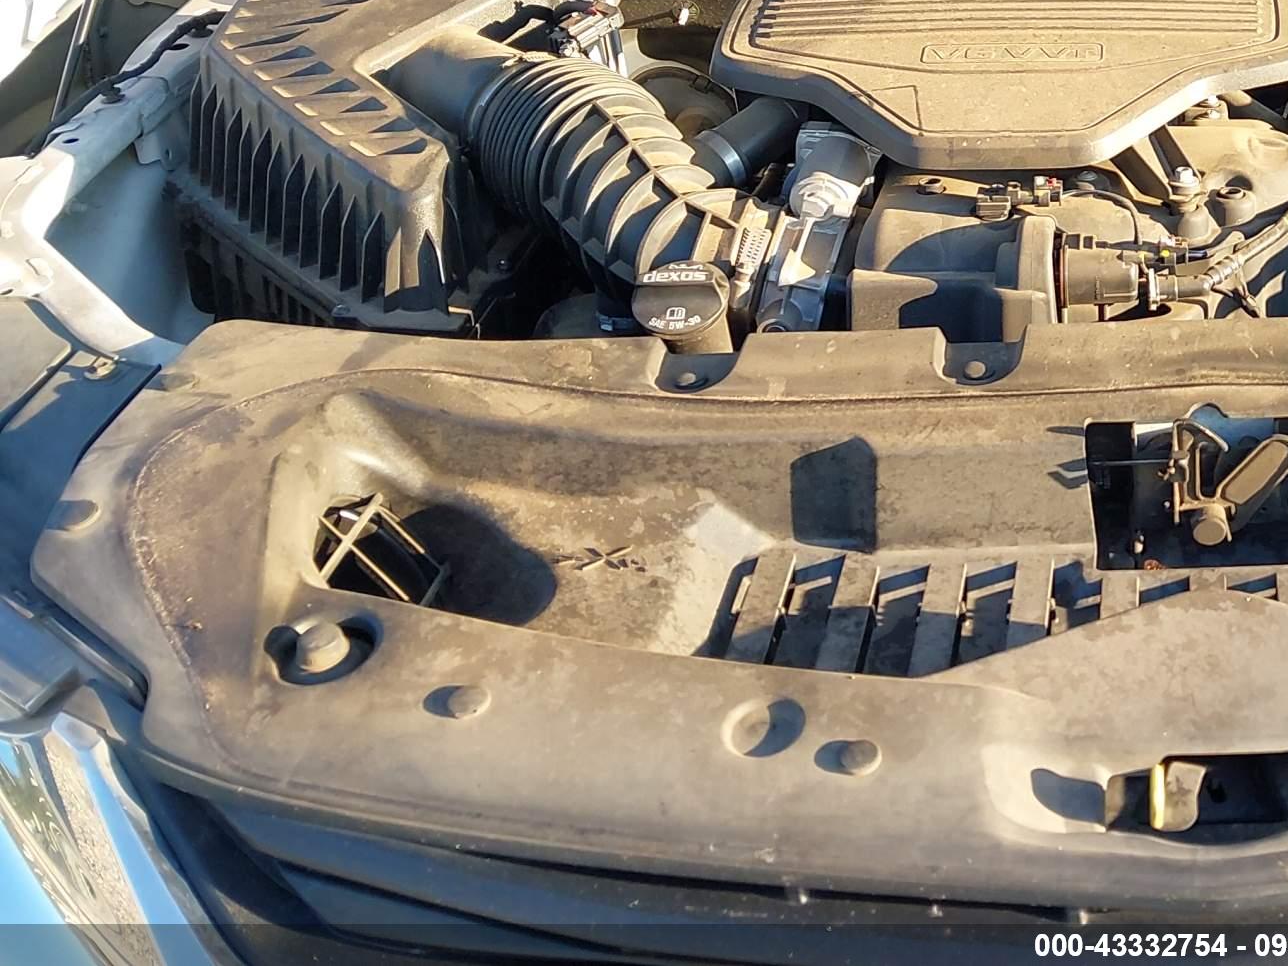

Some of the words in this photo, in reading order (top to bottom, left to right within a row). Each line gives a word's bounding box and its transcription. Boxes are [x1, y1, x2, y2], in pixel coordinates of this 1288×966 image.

[1004, 47, 1098, 60] VVT
[643, 271, 708, 282] dexos
[648, 317, 667, 329] SAE
[668, 315, 702, 330] 5W-30
